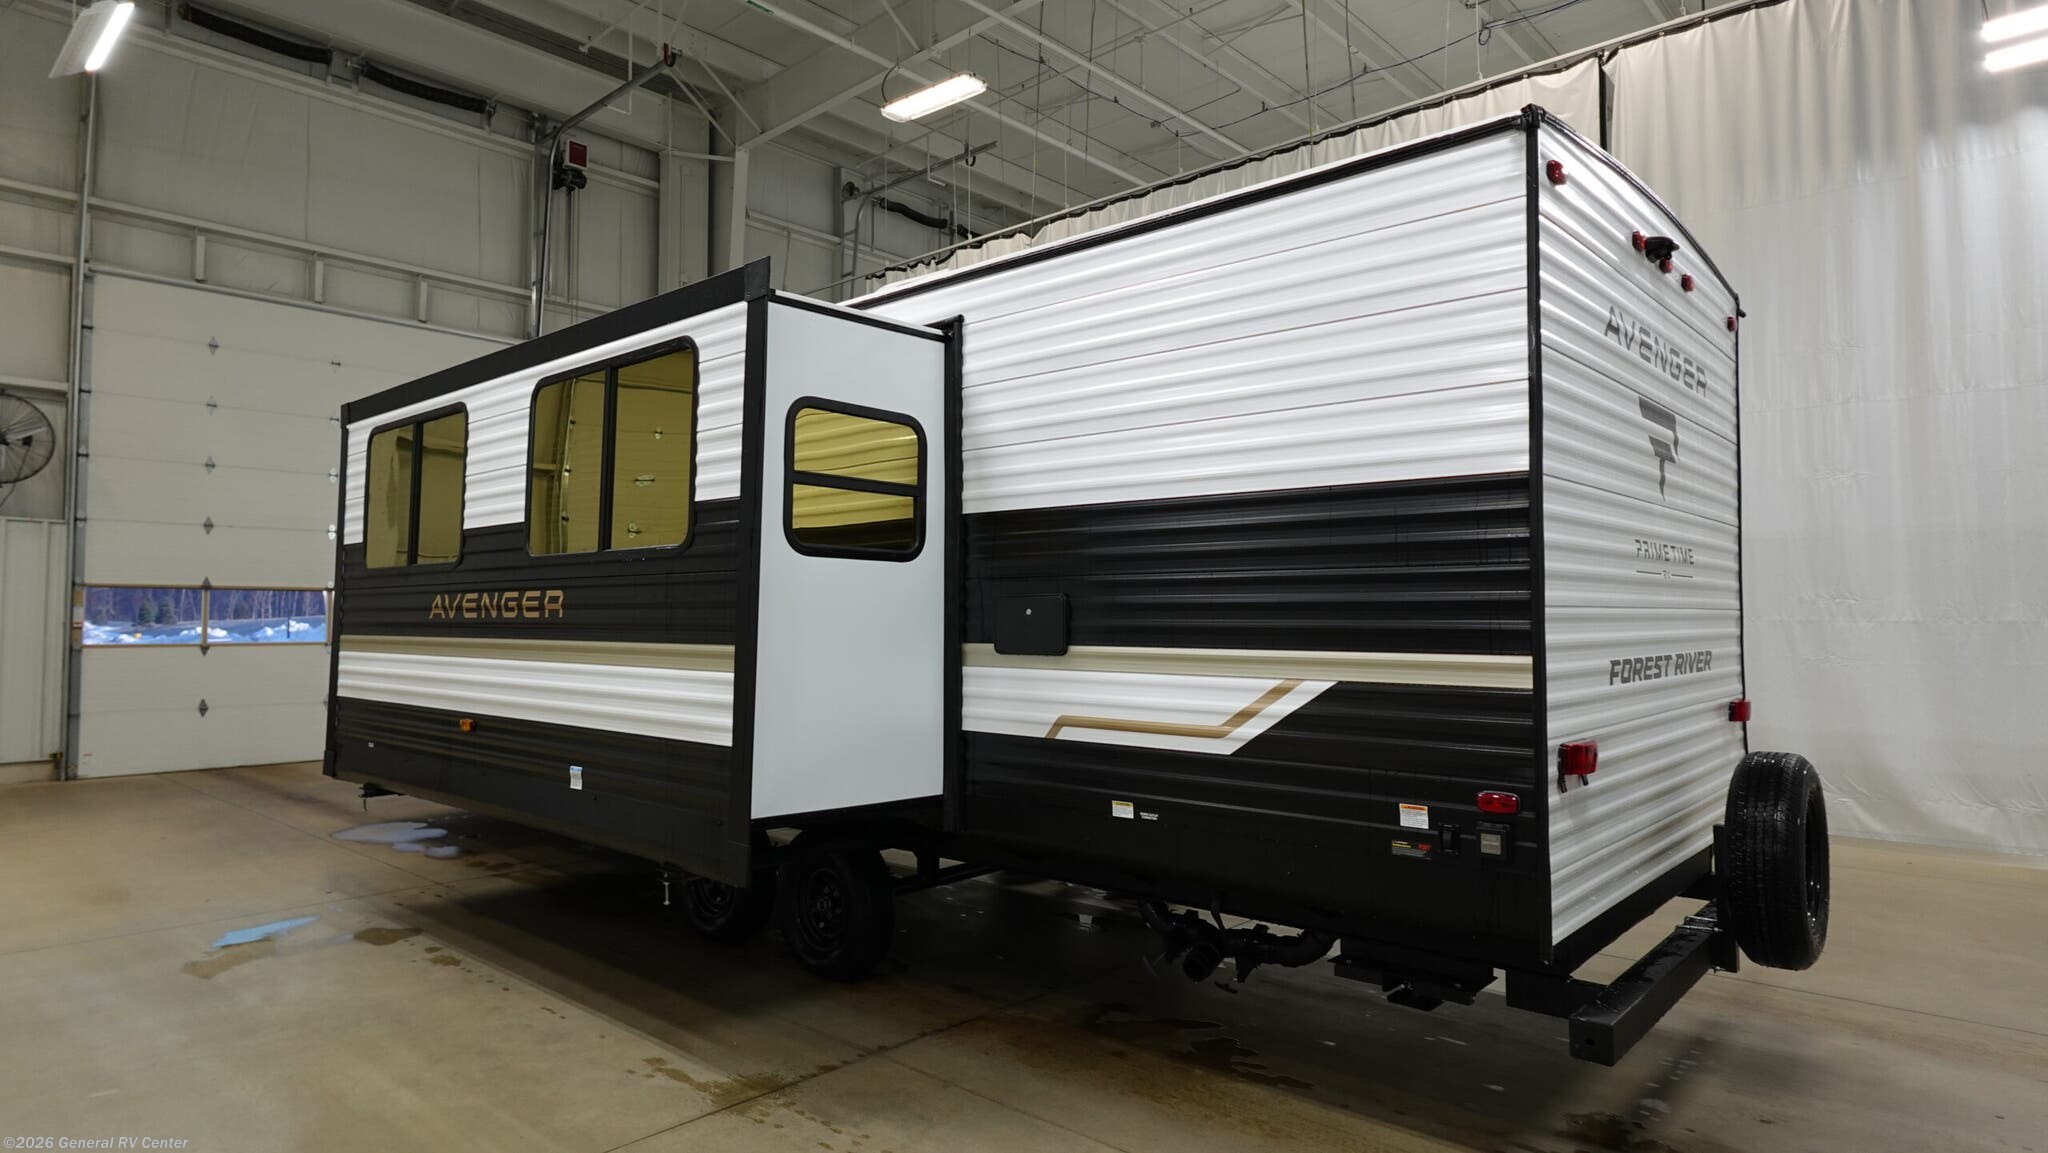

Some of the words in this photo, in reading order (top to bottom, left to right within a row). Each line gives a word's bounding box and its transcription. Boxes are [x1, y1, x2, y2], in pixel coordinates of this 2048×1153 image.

[1604, 305, 1708, 398] AVENGER
[429, 589, 564, 620] AVENGER
[1609, 654, 1673, 686] FOREST
[1674, 650, 1713, 676] RIVER
